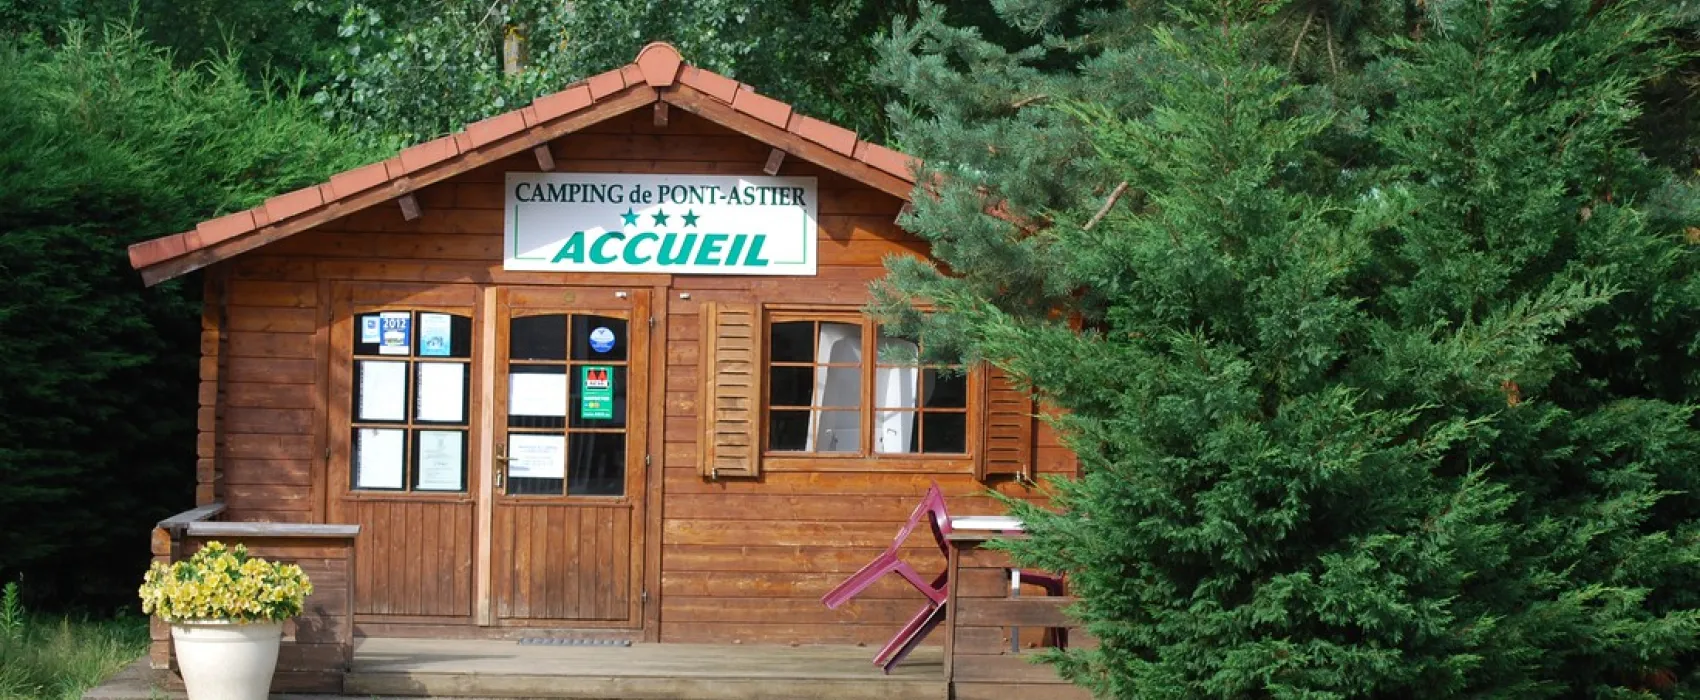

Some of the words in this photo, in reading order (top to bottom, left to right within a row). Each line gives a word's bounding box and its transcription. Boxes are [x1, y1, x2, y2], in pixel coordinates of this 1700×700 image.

[515, 182, 623, 204] CAMPING
[629, 183, 652, 204] de
[658, 184, 806, 206] PONT-ASTIER
[550, 231, 770, 266] ACCUEIL
[382, 317, 406, 328] 2012
